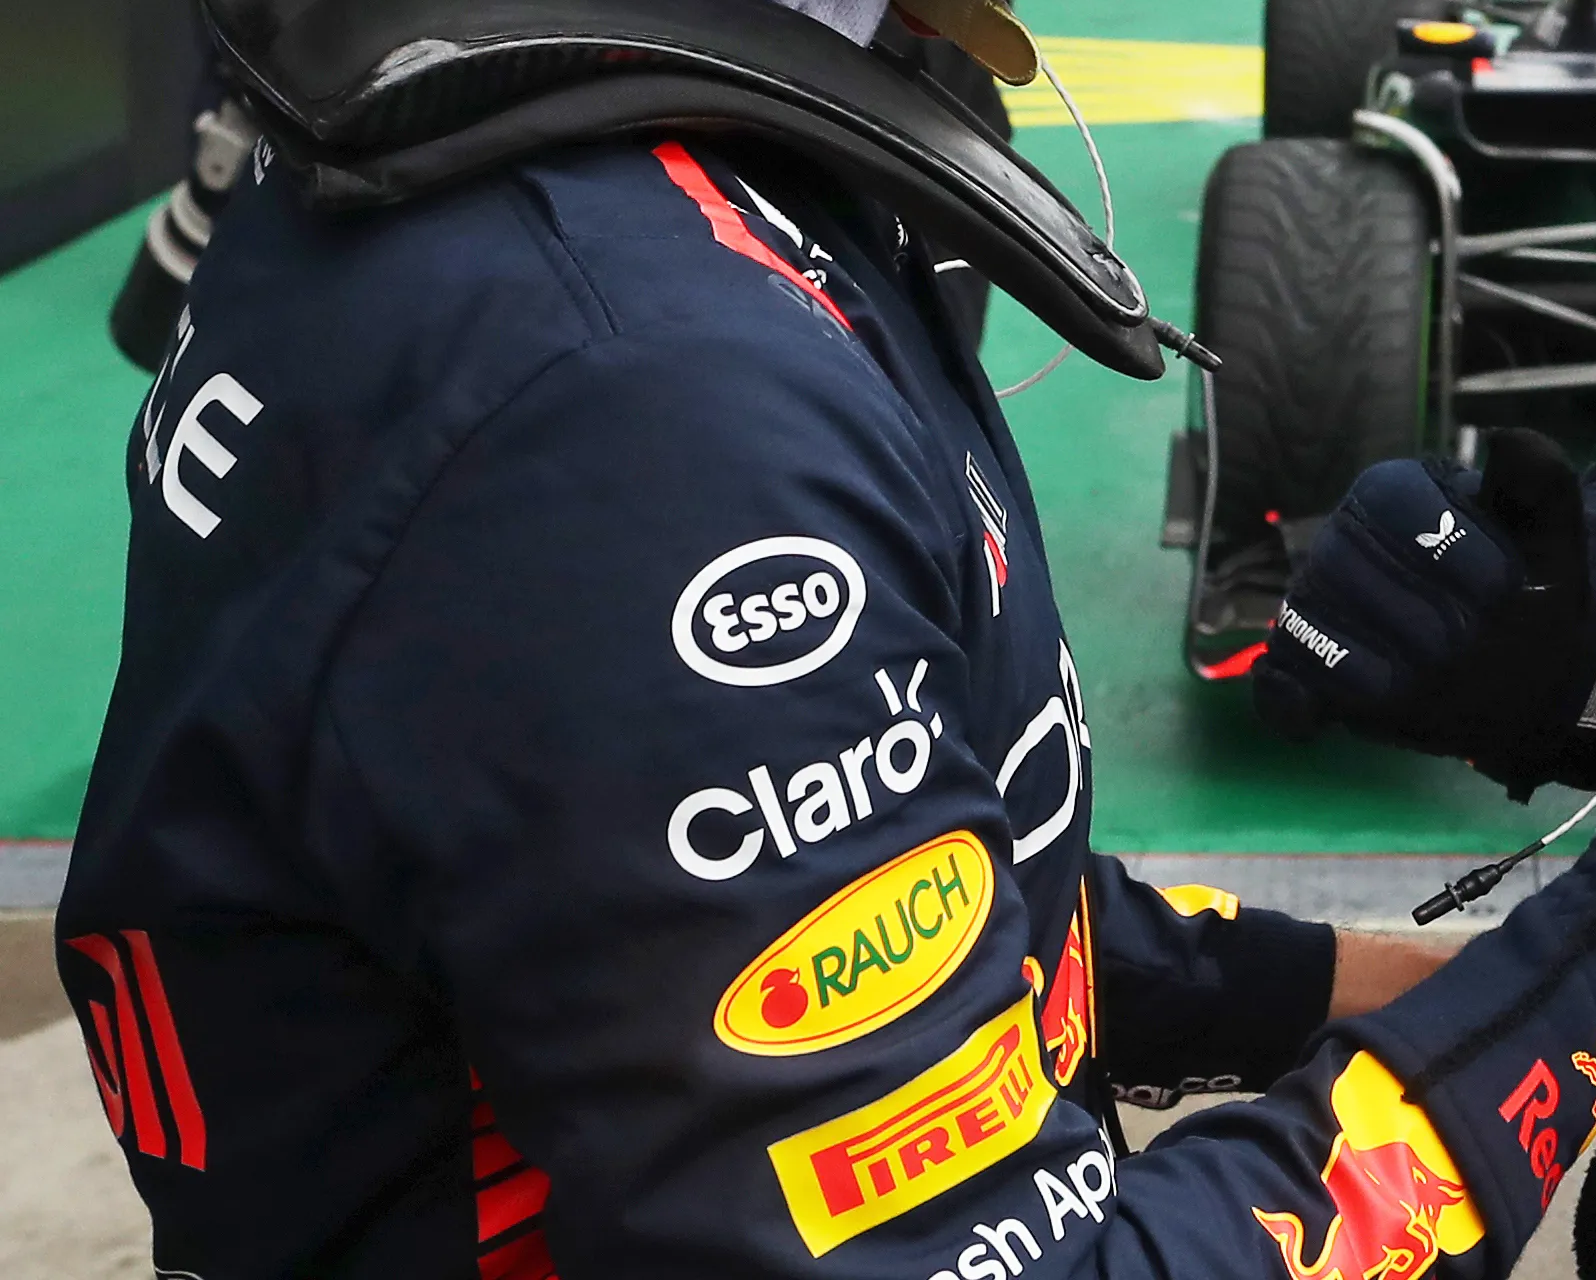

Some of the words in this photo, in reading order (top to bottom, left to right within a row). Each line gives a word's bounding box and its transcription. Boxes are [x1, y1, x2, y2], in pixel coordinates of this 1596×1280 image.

[667, 710, 938, 883] Claro
[811, 853, 971, 1009] RAUCH
[809, 1023, 1031, 1219] PIRELLI
